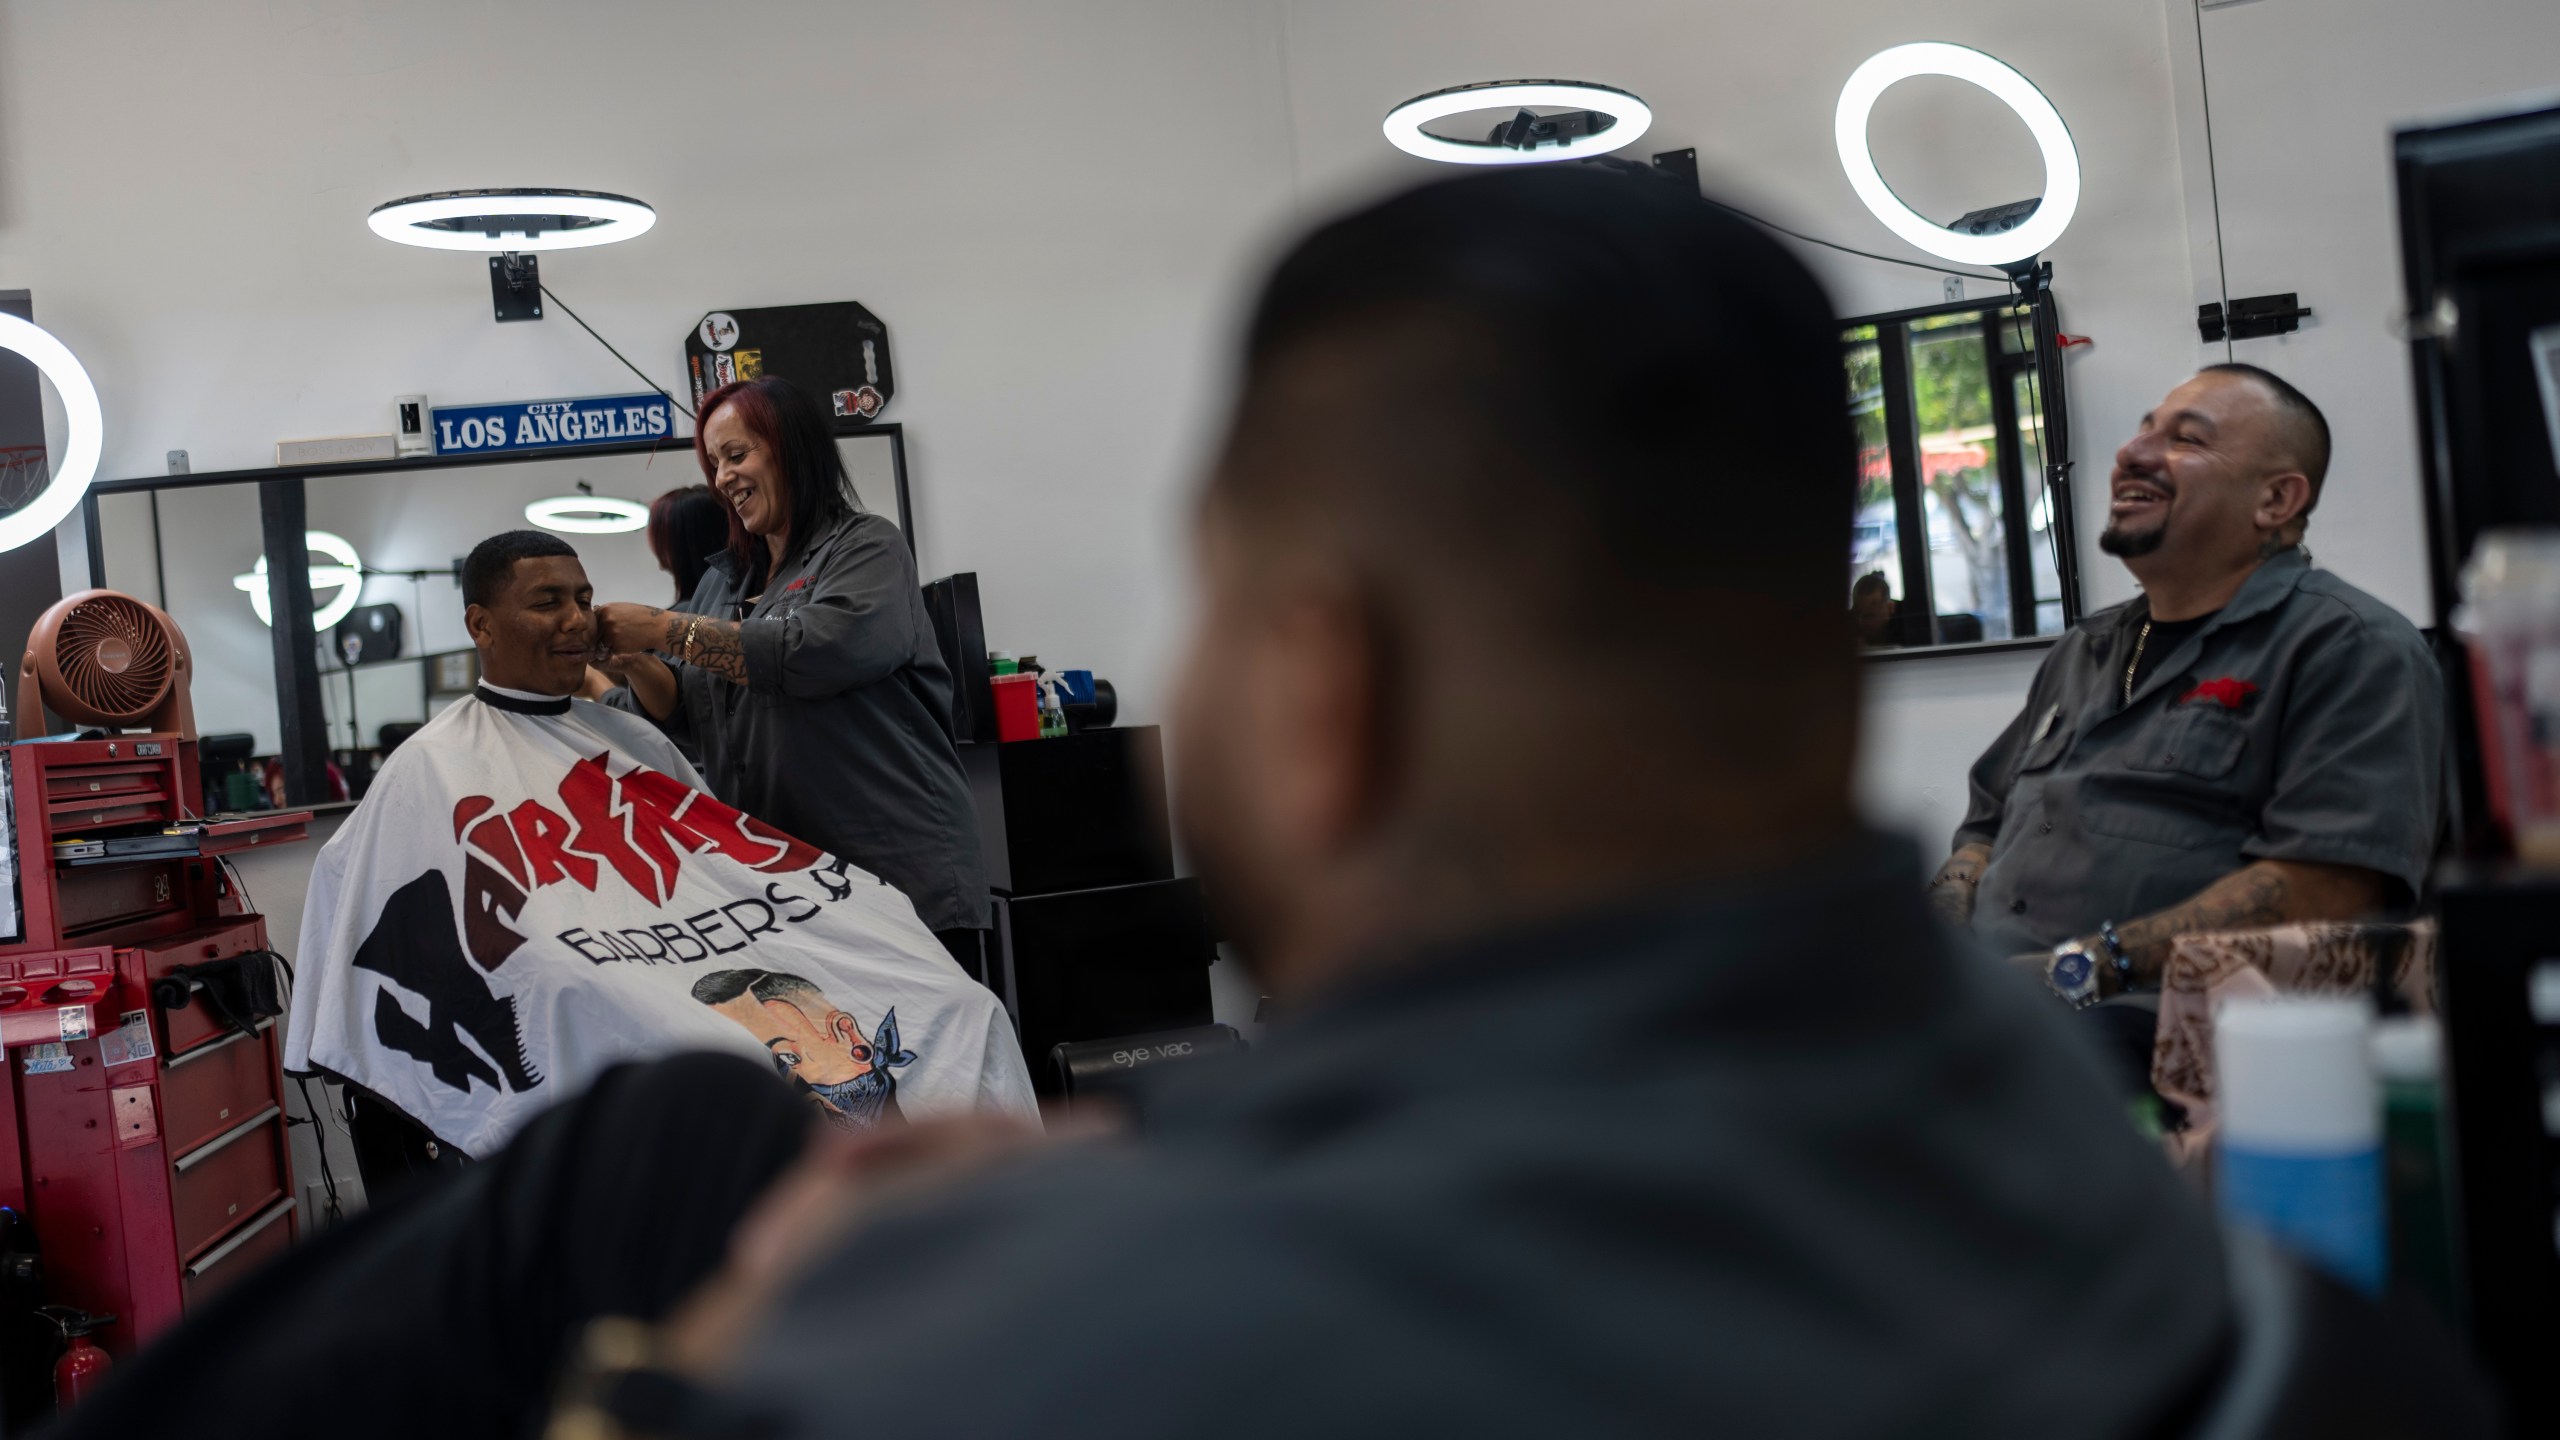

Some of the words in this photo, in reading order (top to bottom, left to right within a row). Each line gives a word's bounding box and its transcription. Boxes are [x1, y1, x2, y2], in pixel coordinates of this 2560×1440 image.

[527, 402, 574, 415] CITY
[440, 416, 506, 449] LOS
[515, 405, 667, 445] ANGELES
[154, 873, 170, 903] 24
[556, 882, 821, 966] BARBERS
[1113, 1047, 1150, 1068] eye
[1155, 1042, 1193, 1058] vac
